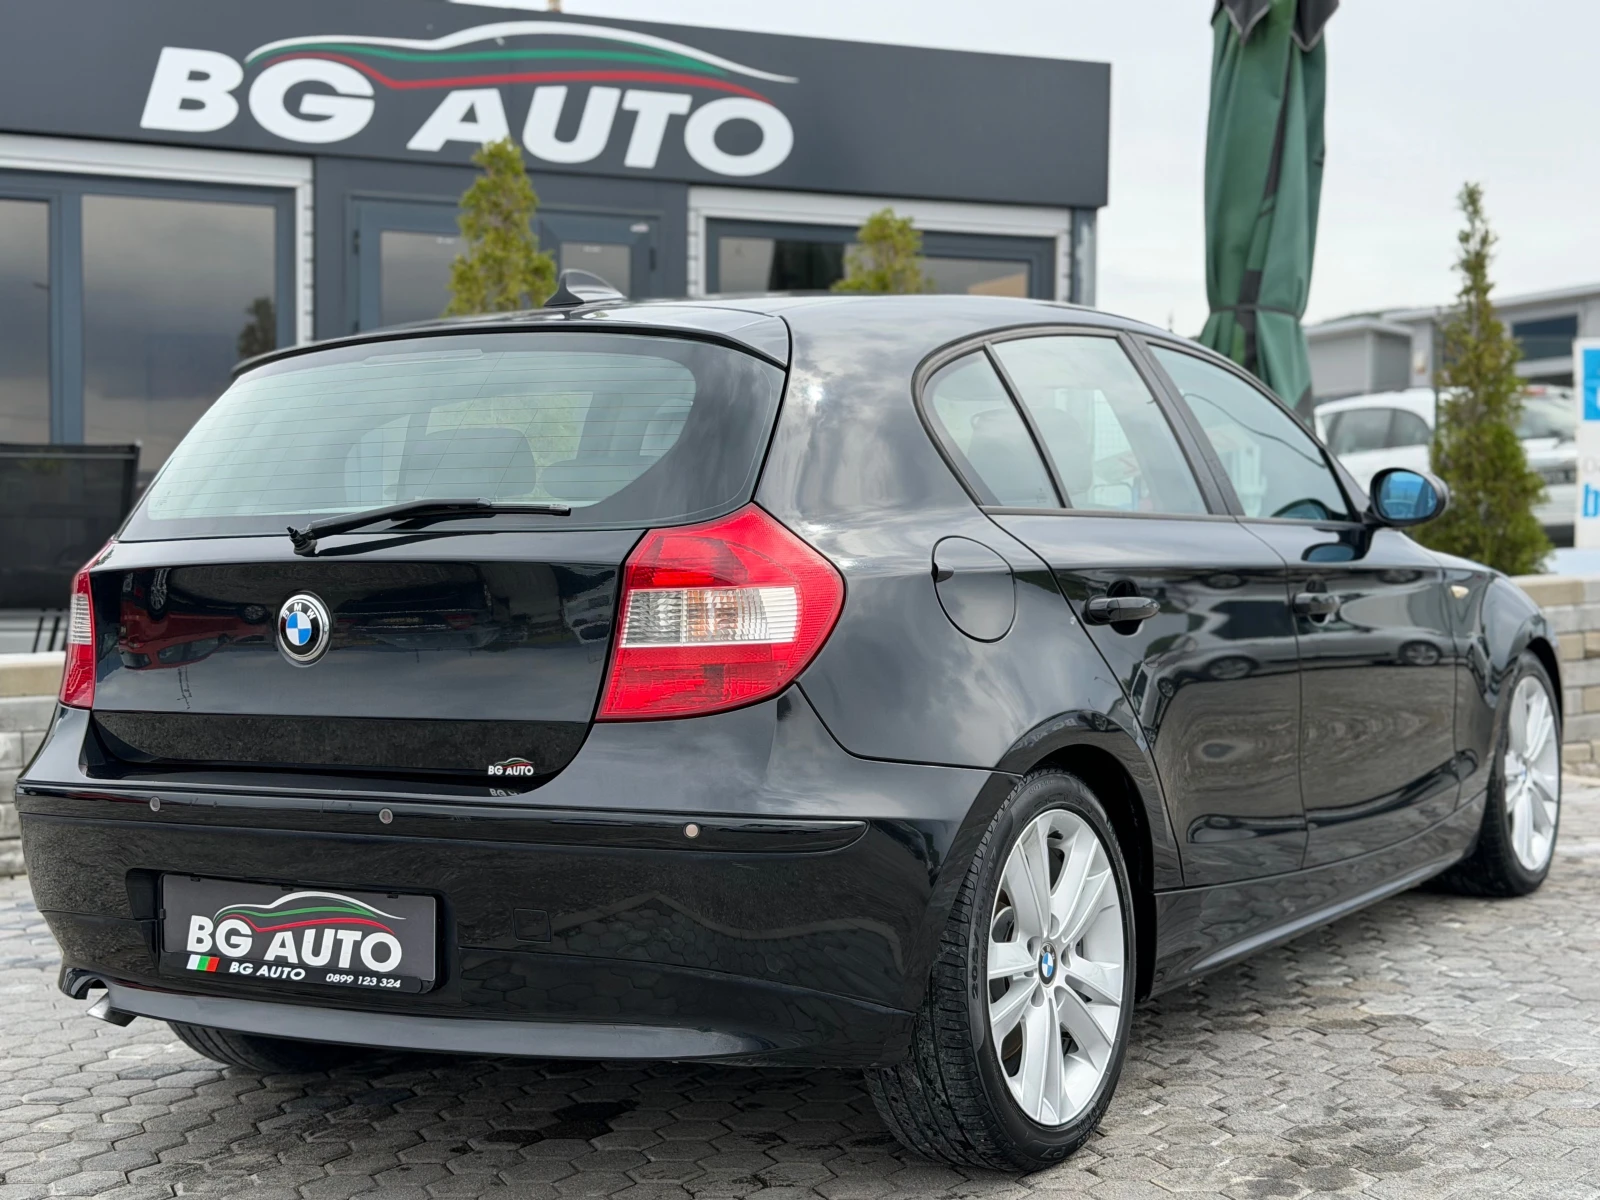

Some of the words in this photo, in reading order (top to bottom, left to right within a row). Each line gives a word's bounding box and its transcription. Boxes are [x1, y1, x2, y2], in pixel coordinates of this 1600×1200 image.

[140, 46, 375, 144] BG
[406, 85, 794, 176] AUTO
[282, 602, 317, 620] BMW
[487, 765, 503, 776] BG
[505, 765, 534, 776] AUTO
[186, 914, 253, 958] BG
[263, 928, 403, 973] AUTO
[229, 961, 254, 975] BG
[256, 964, 306, 981] AUTO
[326, 973, 354, 984] 0899
[358, 976, 378, 986] 123
[379, 978, 401, 989] 324
